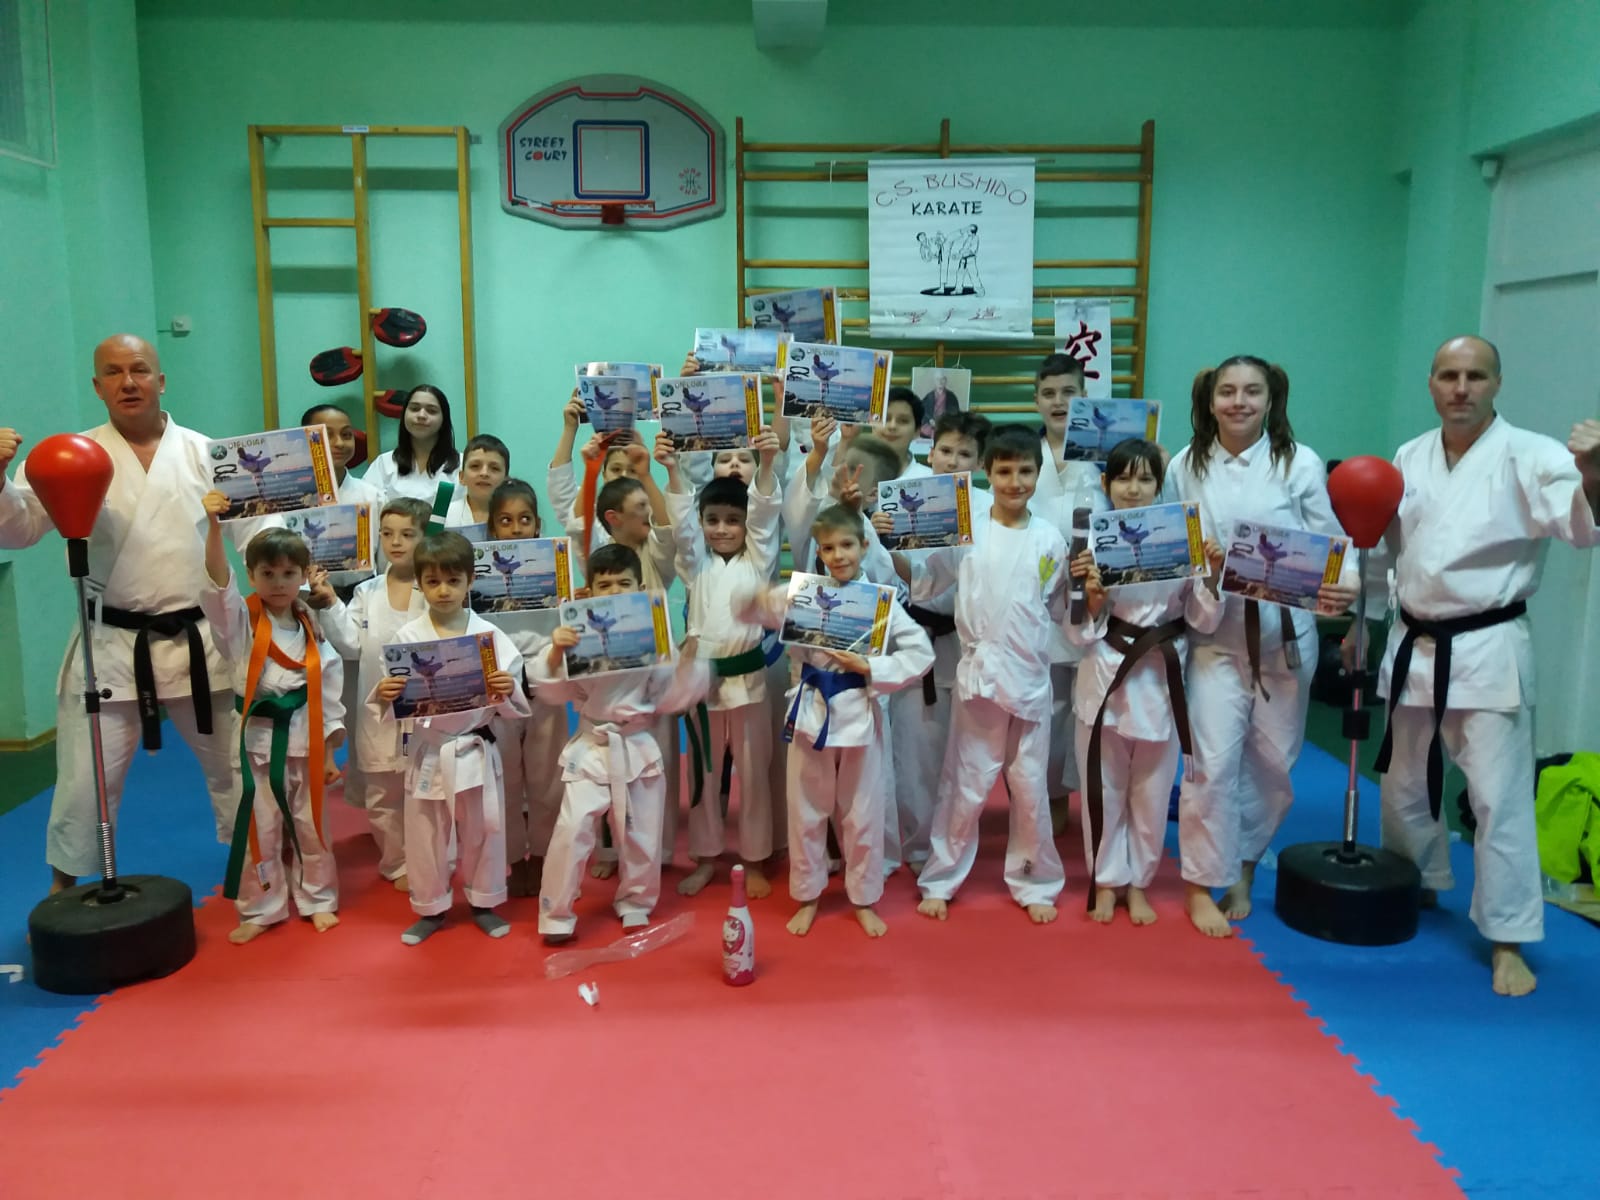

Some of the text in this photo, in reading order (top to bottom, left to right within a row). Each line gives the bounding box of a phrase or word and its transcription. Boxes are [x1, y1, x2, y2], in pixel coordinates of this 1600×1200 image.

[519, 136, 565, 148] STREET
[923, 171, 1027, 206] BUSHIDO
[911, 200, 983, 216] KARATE
